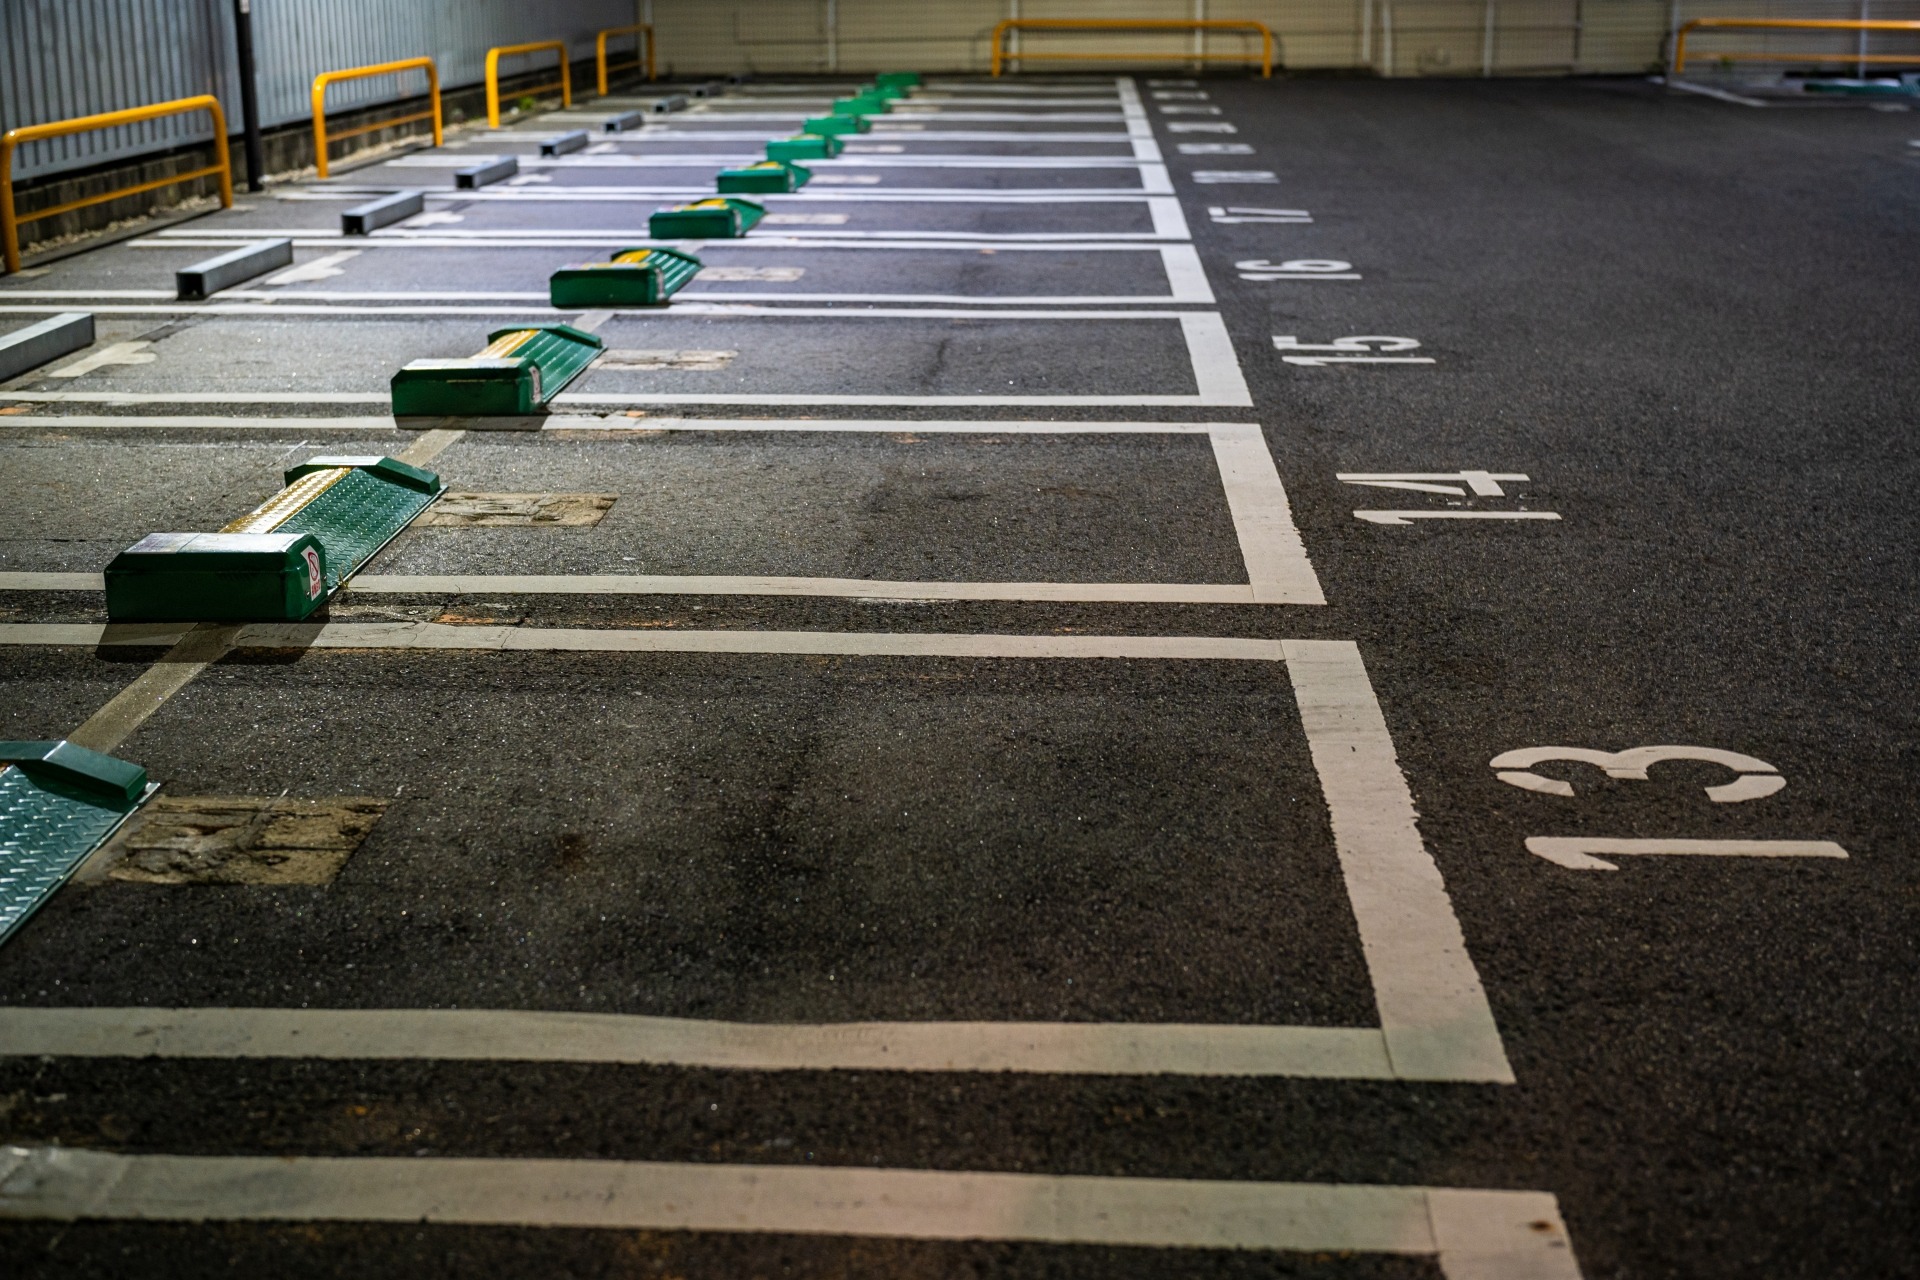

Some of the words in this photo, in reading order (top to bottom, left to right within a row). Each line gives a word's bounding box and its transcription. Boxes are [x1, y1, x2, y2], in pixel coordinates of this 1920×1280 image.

[1207, 206, 1314, 224] 17
[1235, 258, 1363, 281] 16
[1272, 335, 1436, 366] 15
[1335, 470, 1562, 525] 14
[1489, 745, 1849, 870] 13
